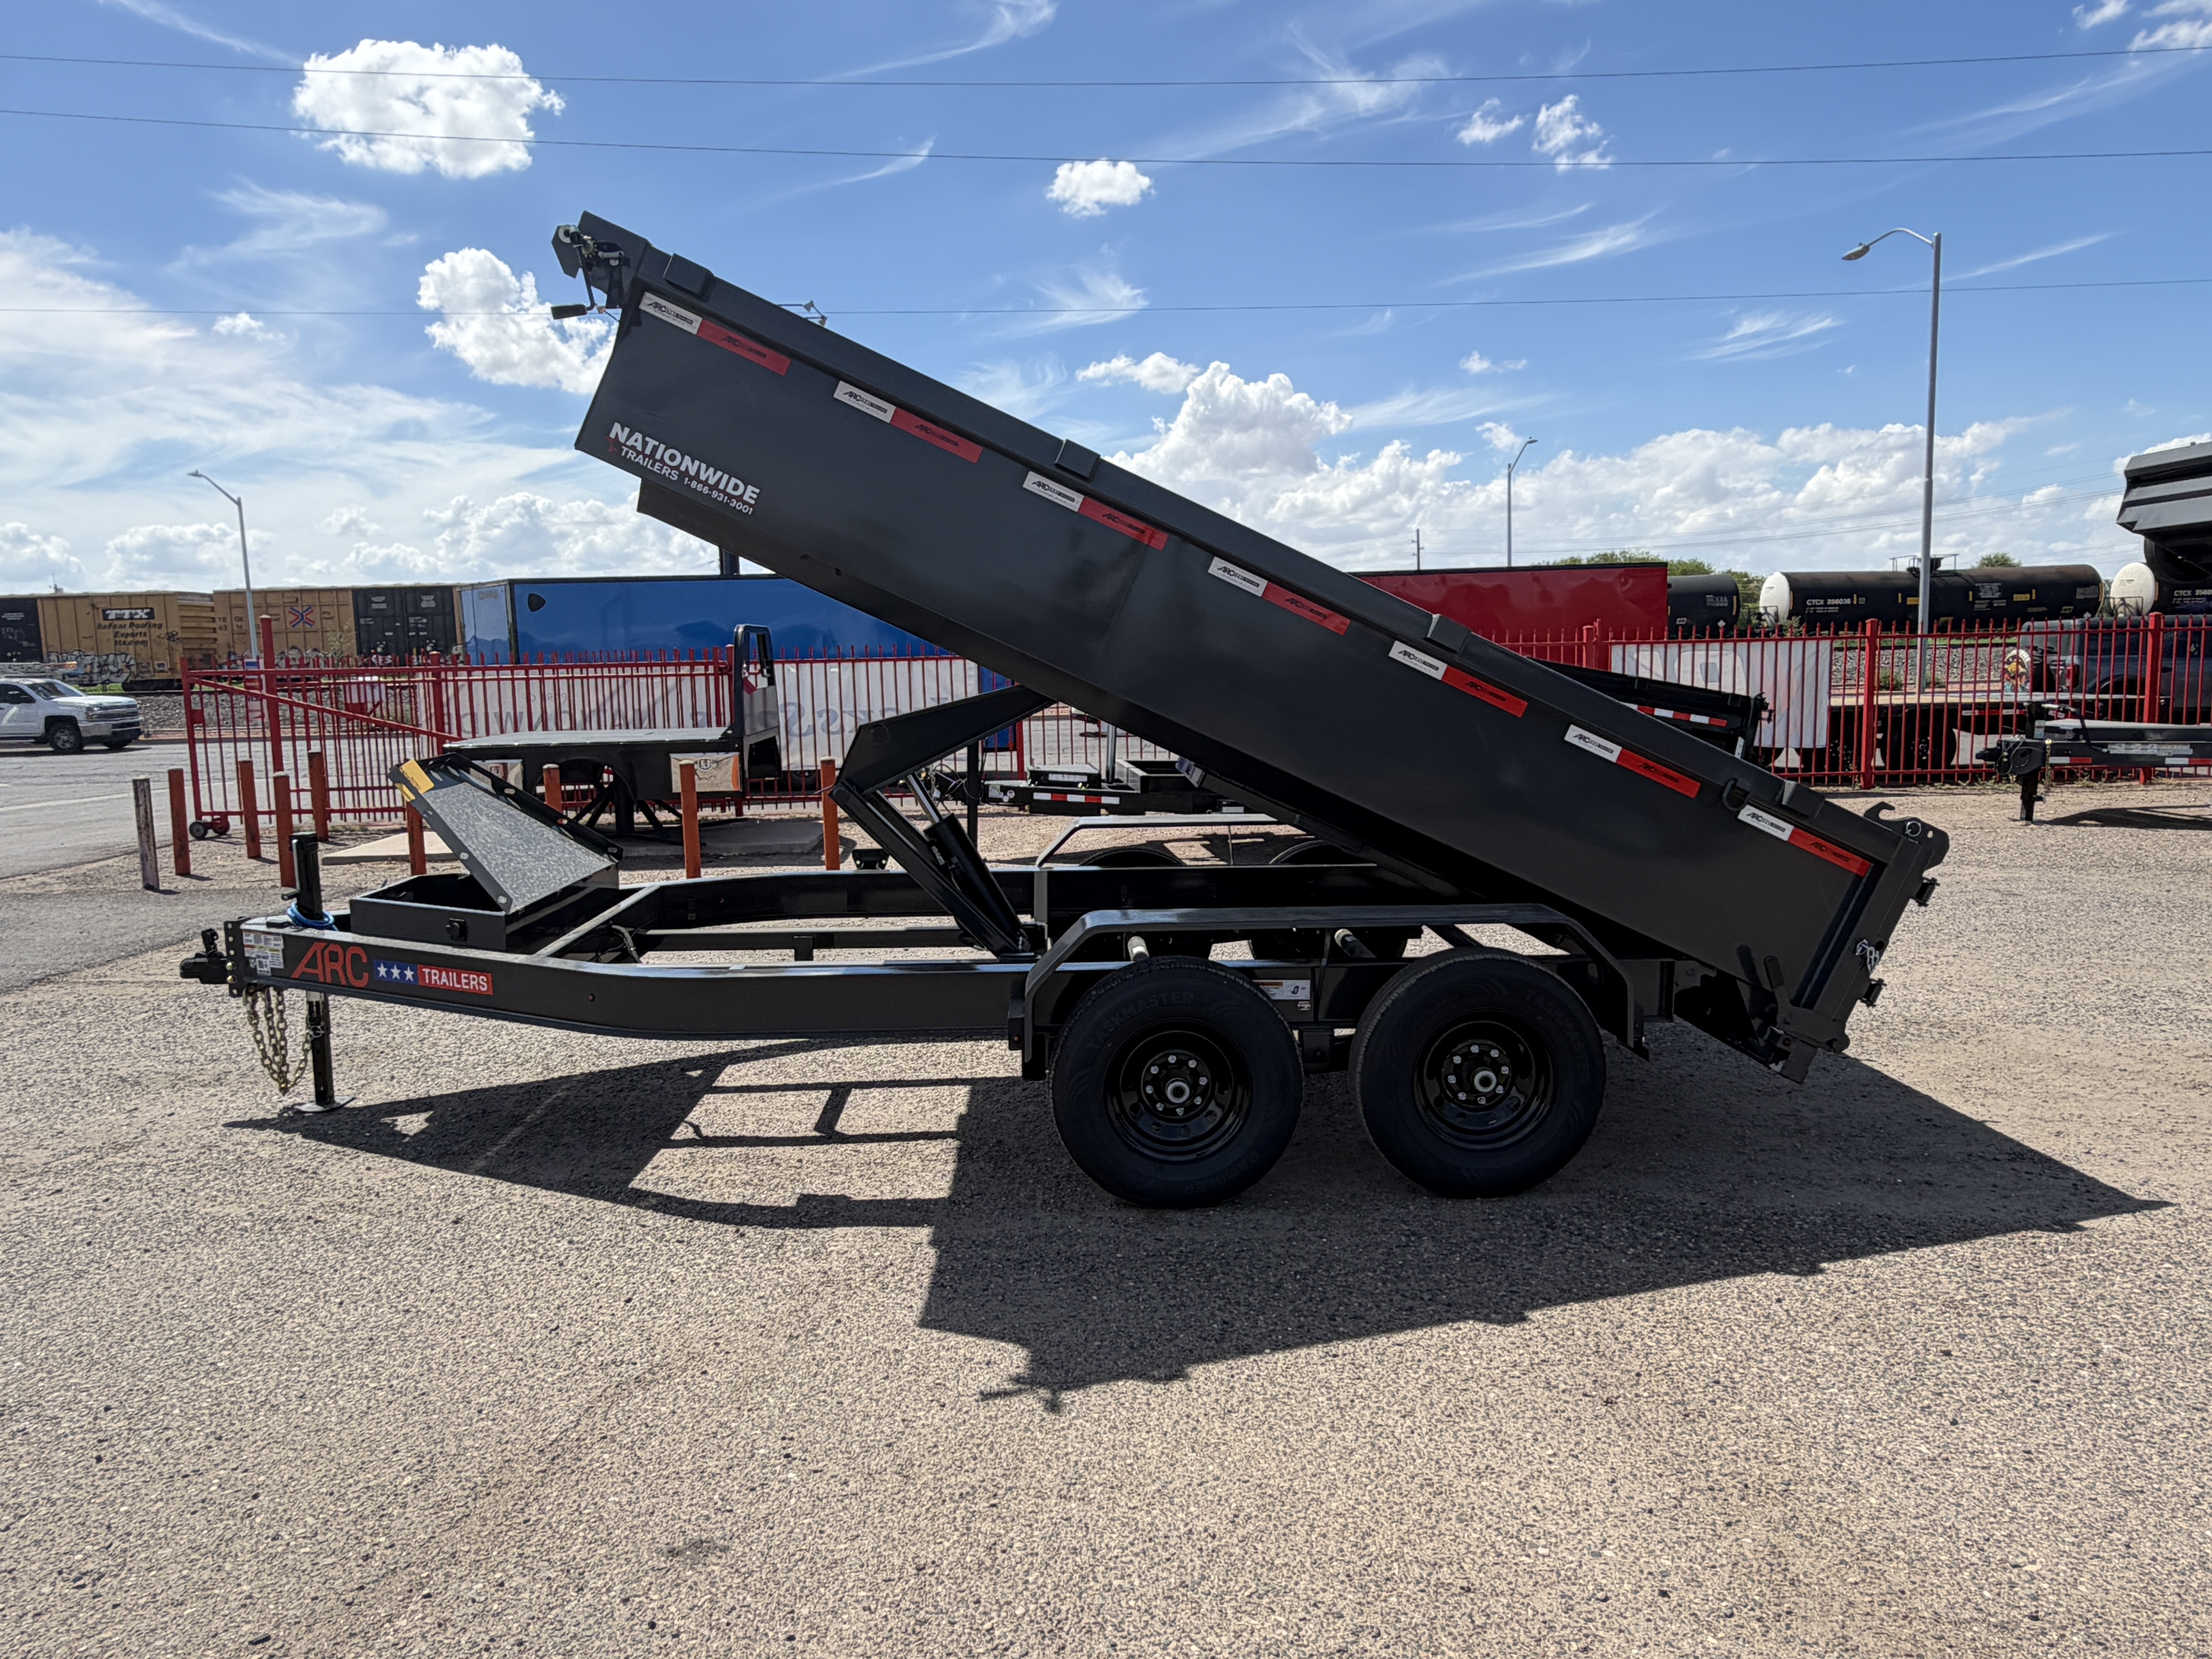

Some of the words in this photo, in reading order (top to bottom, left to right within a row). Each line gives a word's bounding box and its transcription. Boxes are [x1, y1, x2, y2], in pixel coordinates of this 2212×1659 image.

[609, 422, 759, 504] NATIONWIDE
[621, 446, 679, 481] TRAILERS
[684, 477, 753, 515] 1-866-931-3001
[105, 609, 151, 619] TTX
[290, 941, 369, 988] ARC
[422, 968, 487, 991] TRAILERS
